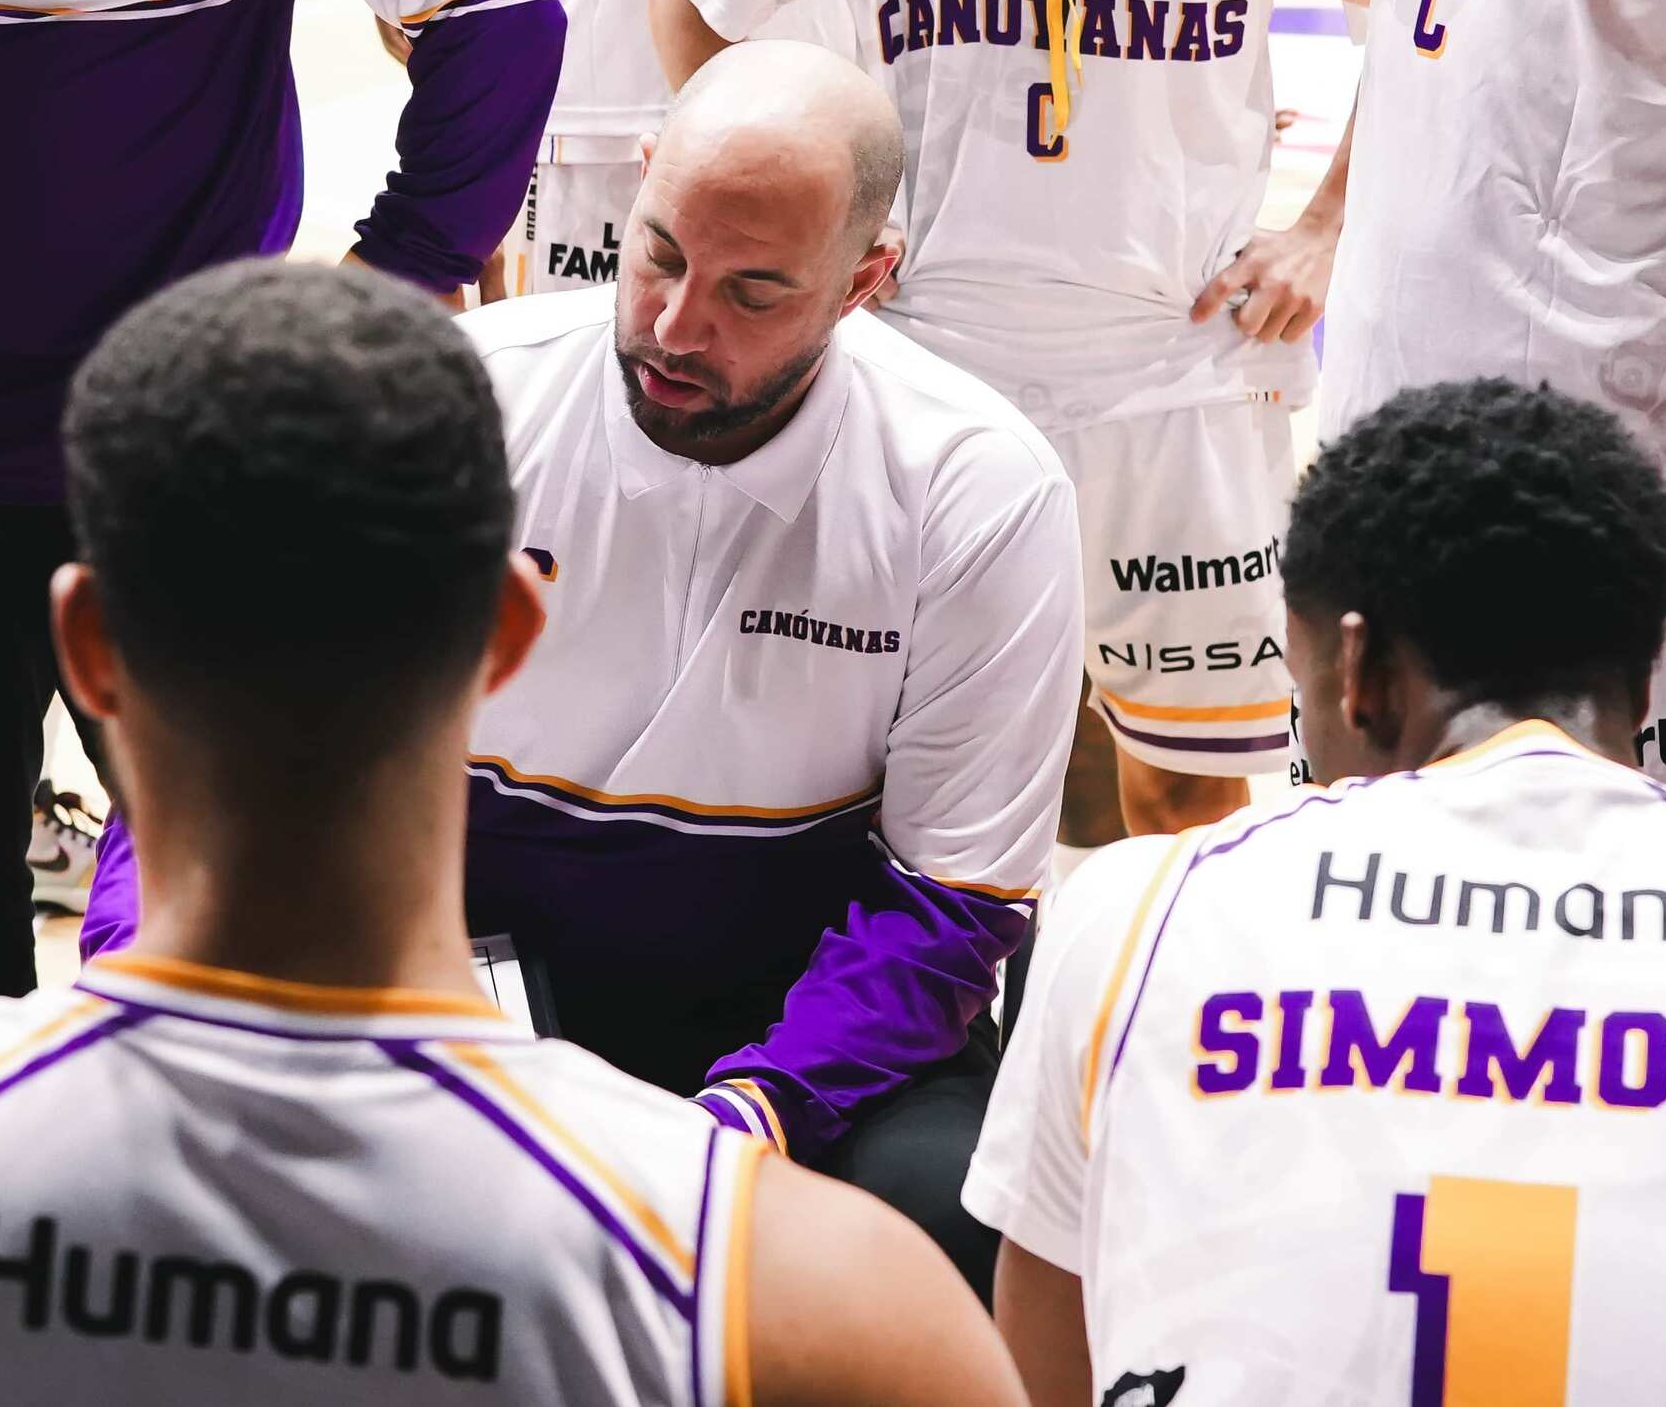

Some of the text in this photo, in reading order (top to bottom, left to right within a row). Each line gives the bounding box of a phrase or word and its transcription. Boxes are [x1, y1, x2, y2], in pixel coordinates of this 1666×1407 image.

[603, 221, 621, 250] L
[1110, 534, 1282, 593] Walmart
[739, 609, 901, 654] CANÓVANAS
[1099, 636, 1284, 673] NISSA
